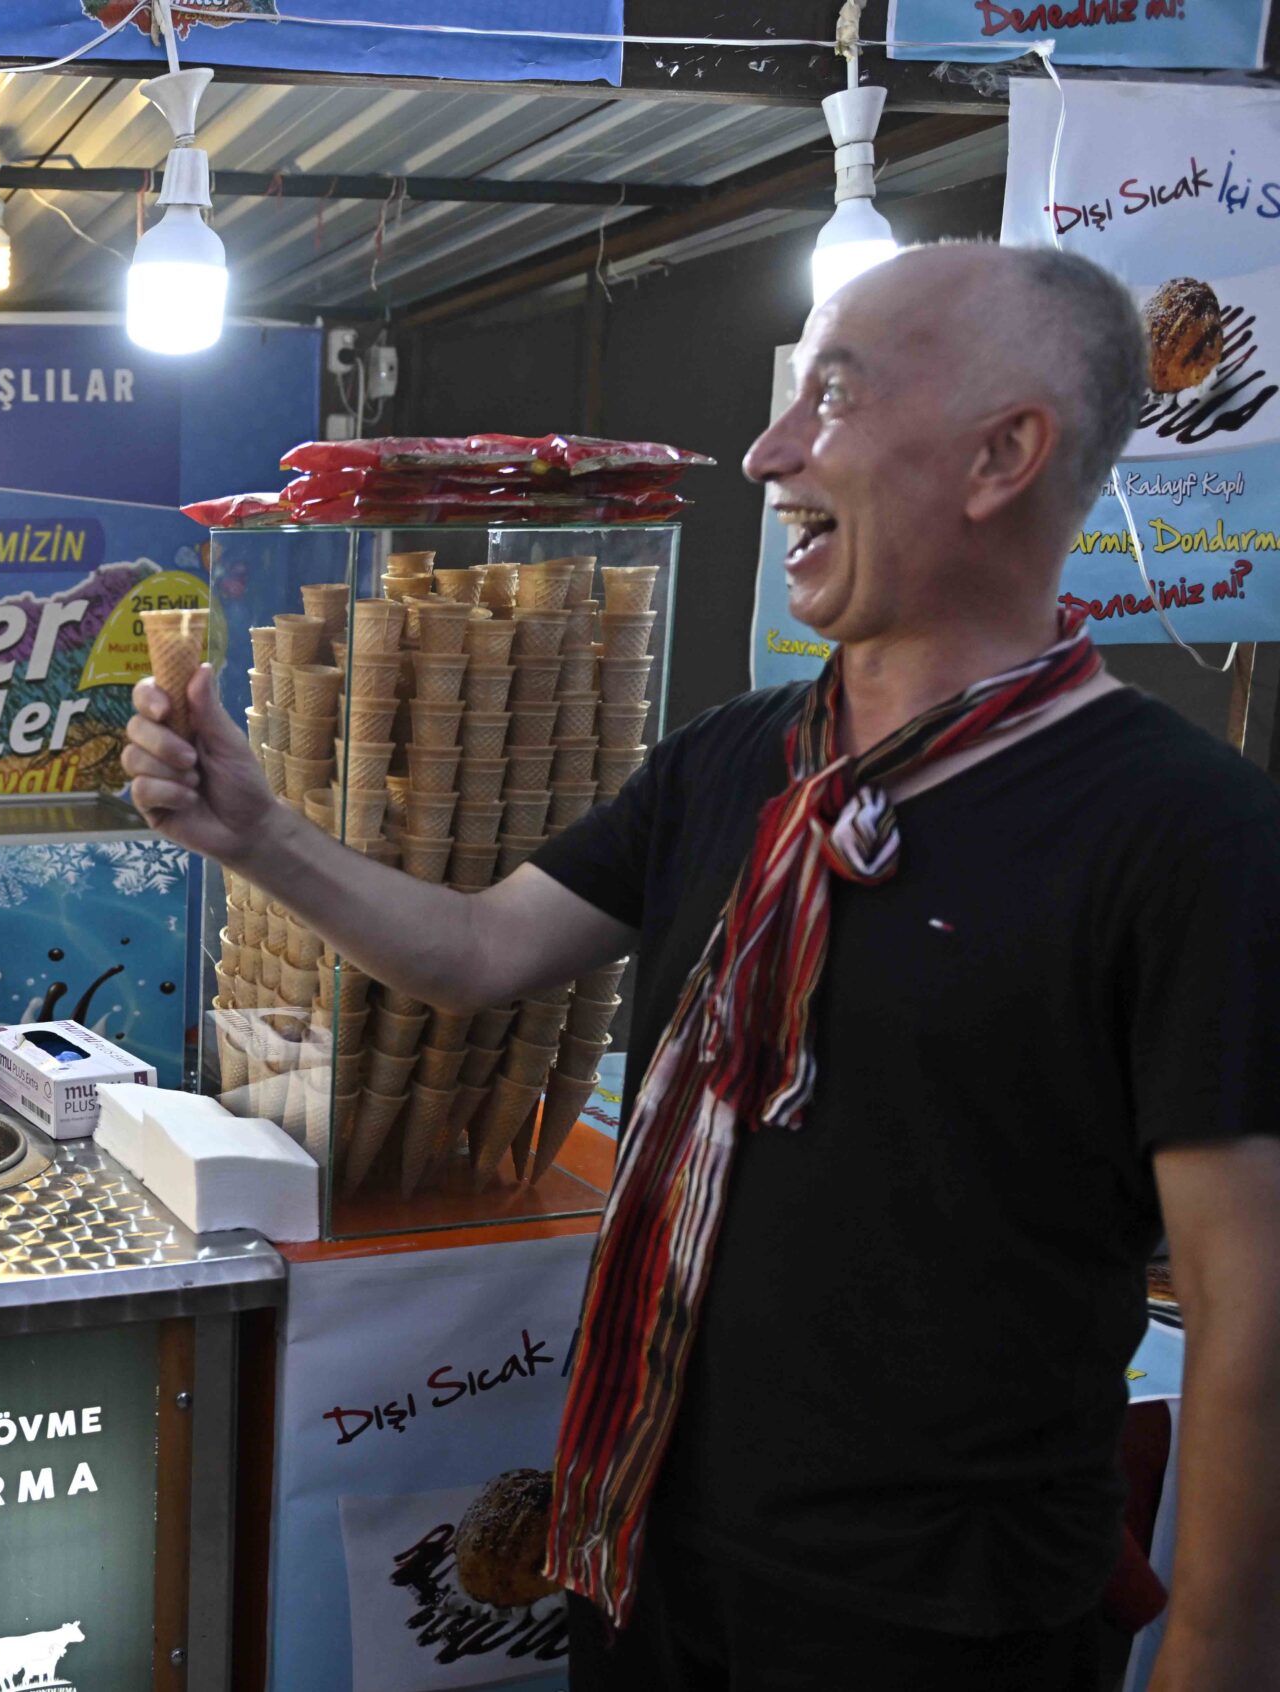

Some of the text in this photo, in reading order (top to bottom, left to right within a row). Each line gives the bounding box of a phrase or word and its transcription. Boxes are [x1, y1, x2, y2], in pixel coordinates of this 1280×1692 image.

[1043, 197, 1113, 235] Dışı
[1119, 156, 1214, 215] Sıcak
[1125, 473, 1197, 505] Kadayıf
[1201, 472, 1245, 503] Kaplı
[131, 595, 153, 613] 25
[64, 1098, 96, 1114] PLUS
[322, 1392, 417, 1445] Dışı
[427, 1328, 555, 1408] Sıcak
